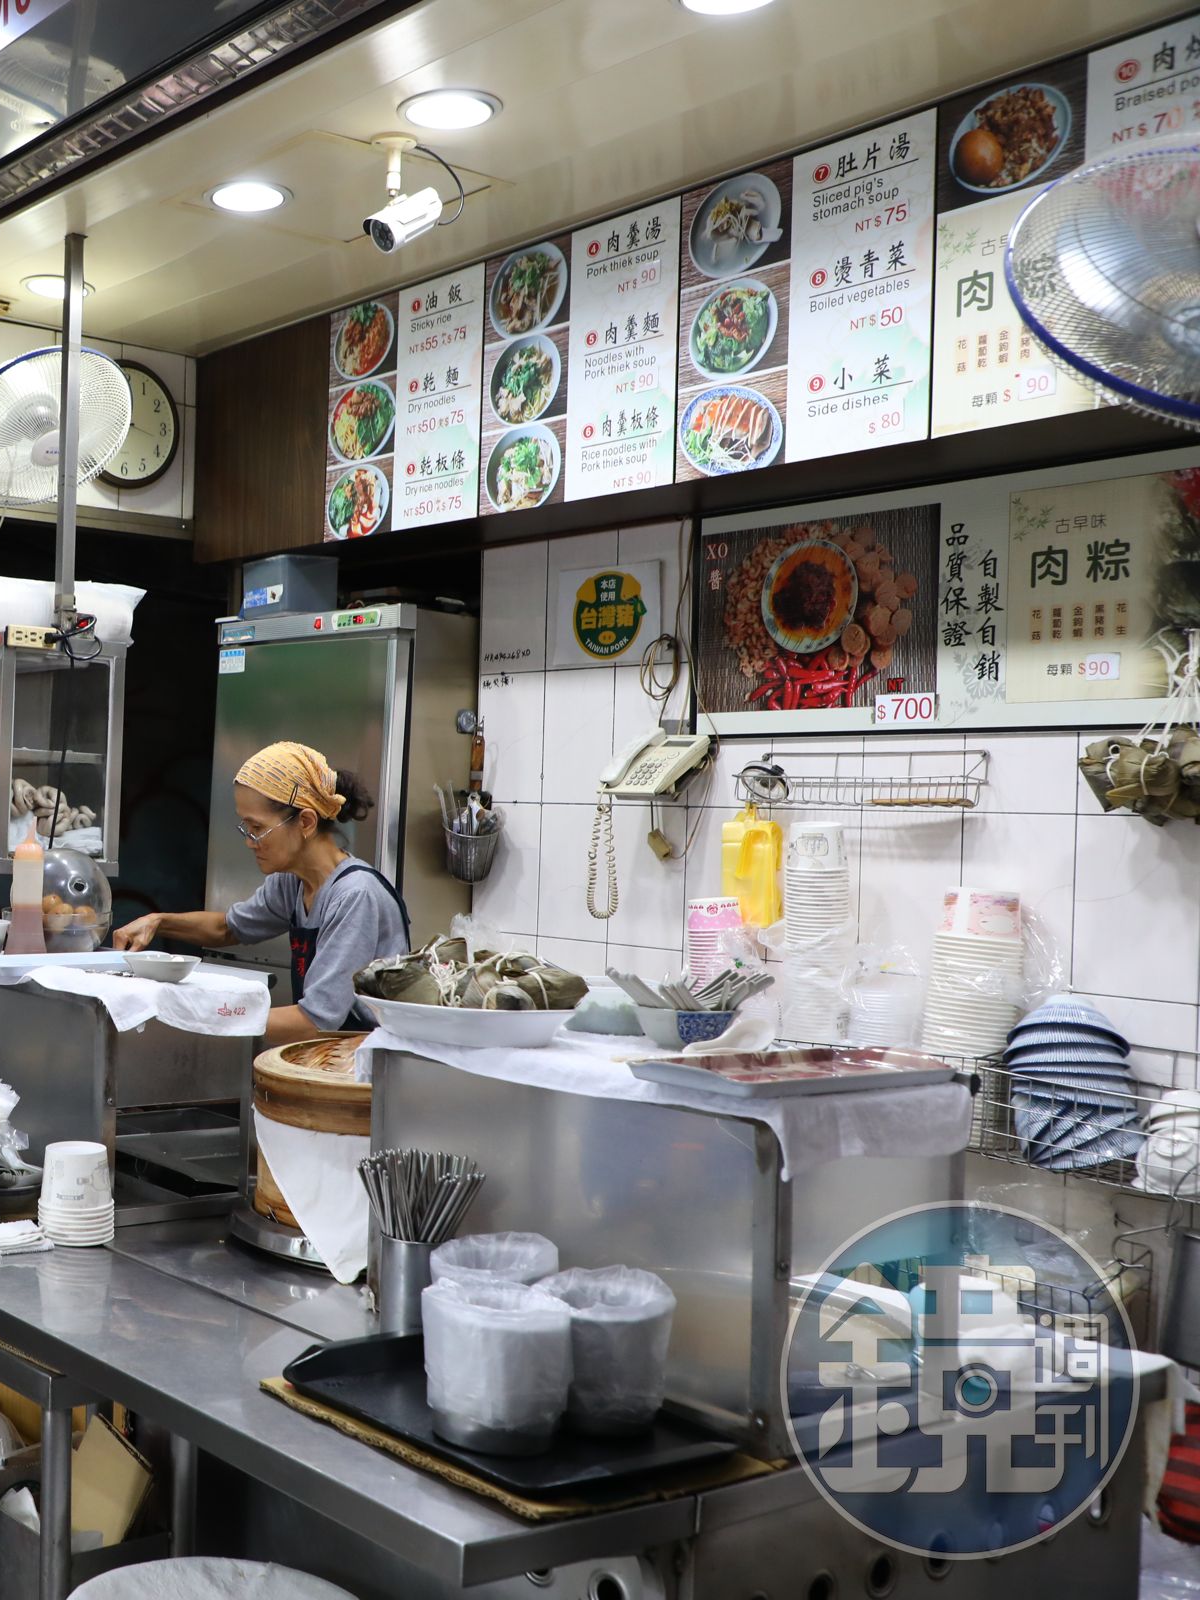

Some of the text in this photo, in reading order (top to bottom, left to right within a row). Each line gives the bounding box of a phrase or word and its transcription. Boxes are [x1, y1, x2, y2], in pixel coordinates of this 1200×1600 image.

[1115, 82, 1176, 111] Braised
[835, 132, 910, 179] 肚片湯
[812, 187, 899, 222] stomach soup
[813, 178, 884, 208] Sliced pig's
[586, 264, 608, 279] Pork
[635, 250, 659, 264] soup
[833, 241, 907, 288] 燙青菜
[424, 282, 463, 312] 油飯
[810, 278, 910, 313] Boiled vegetables
[410, 313, 452, 333] Sticky rice
[584, 345, 644, 369] Noodles with
[584, 368, 605, 380] Pork
[633, 355, 657, 369] soup
[408, 394, 456, 414] Dry noodles
[807, 392, 889, 418] Side dishes
[581, 438, 657, 461] Rice noodles with
[581, 461, 601, 472] Pork
[626, 452, 648, 466] soup
[405, 478, 464, 496] Dry rice noodles
[1055, 513, 1108, 535] 古早味
[706, 542, 729, 560] XO
[1030, 538, 1131, 588] 肉粽
[941, 522, 973, 648] 品質保證
[581, 604, 635, 630] 台灣豬
[974, 549, 1004, 682] 自製自銷
[585, 636, 629, 654] TAIWAN PORK
[887, 678, 905, 692] NT
[233, 1007, 246, 1016] 422
